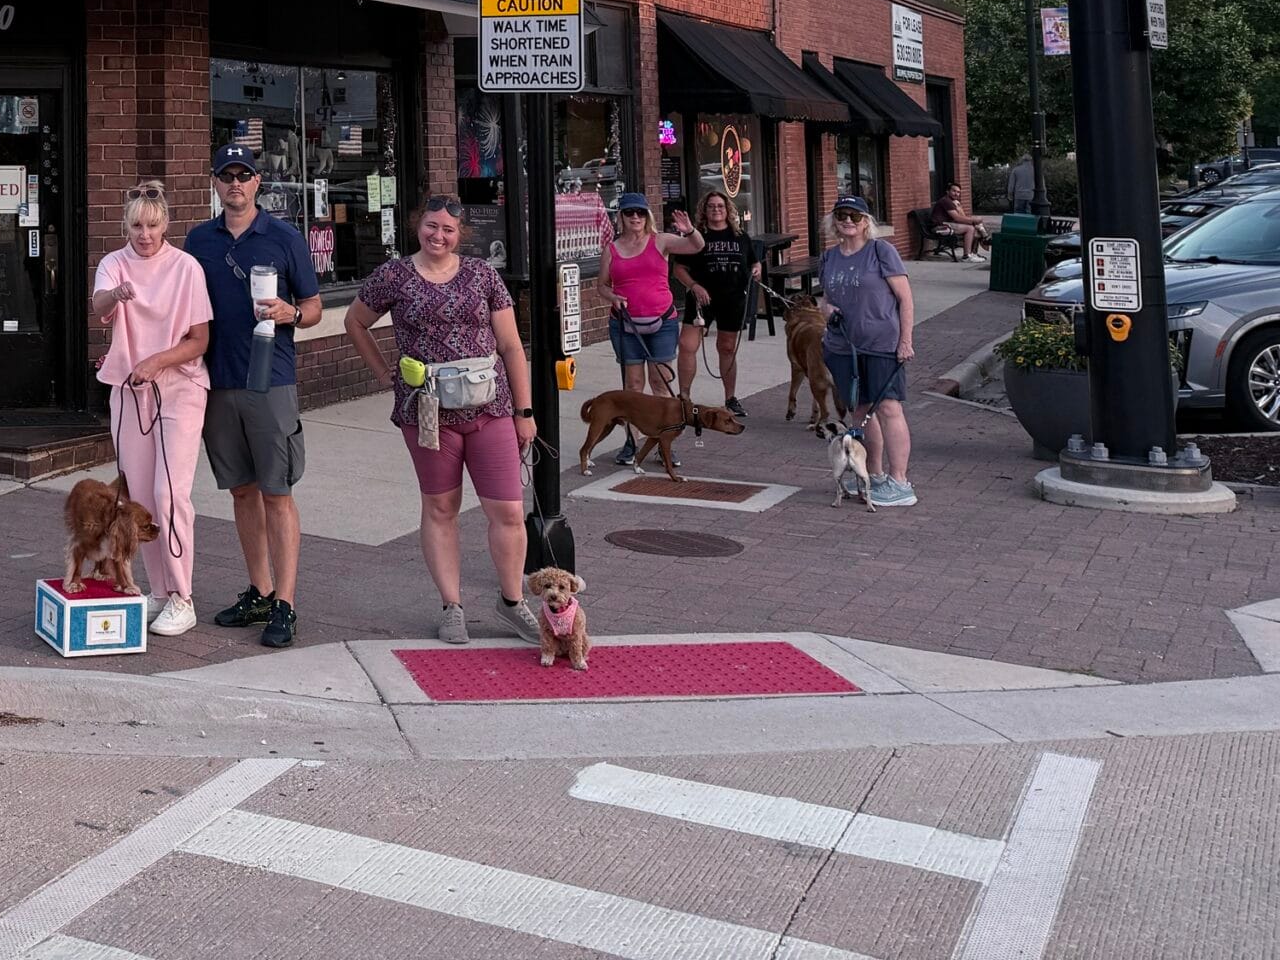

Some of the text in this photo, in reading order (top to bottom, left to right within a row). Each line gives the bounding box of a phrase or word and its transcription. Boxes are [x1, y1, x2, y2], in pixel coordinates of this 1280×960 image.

[493, 19, 567, 33] WALK TIME
[491, 37, 570, 50] SHORTENED
[489, 54, 572, 67] WHEN TRAIN
[485, 71, 577, 85] APPROACHES
[310, 229, 334, 251] OSWEGO
